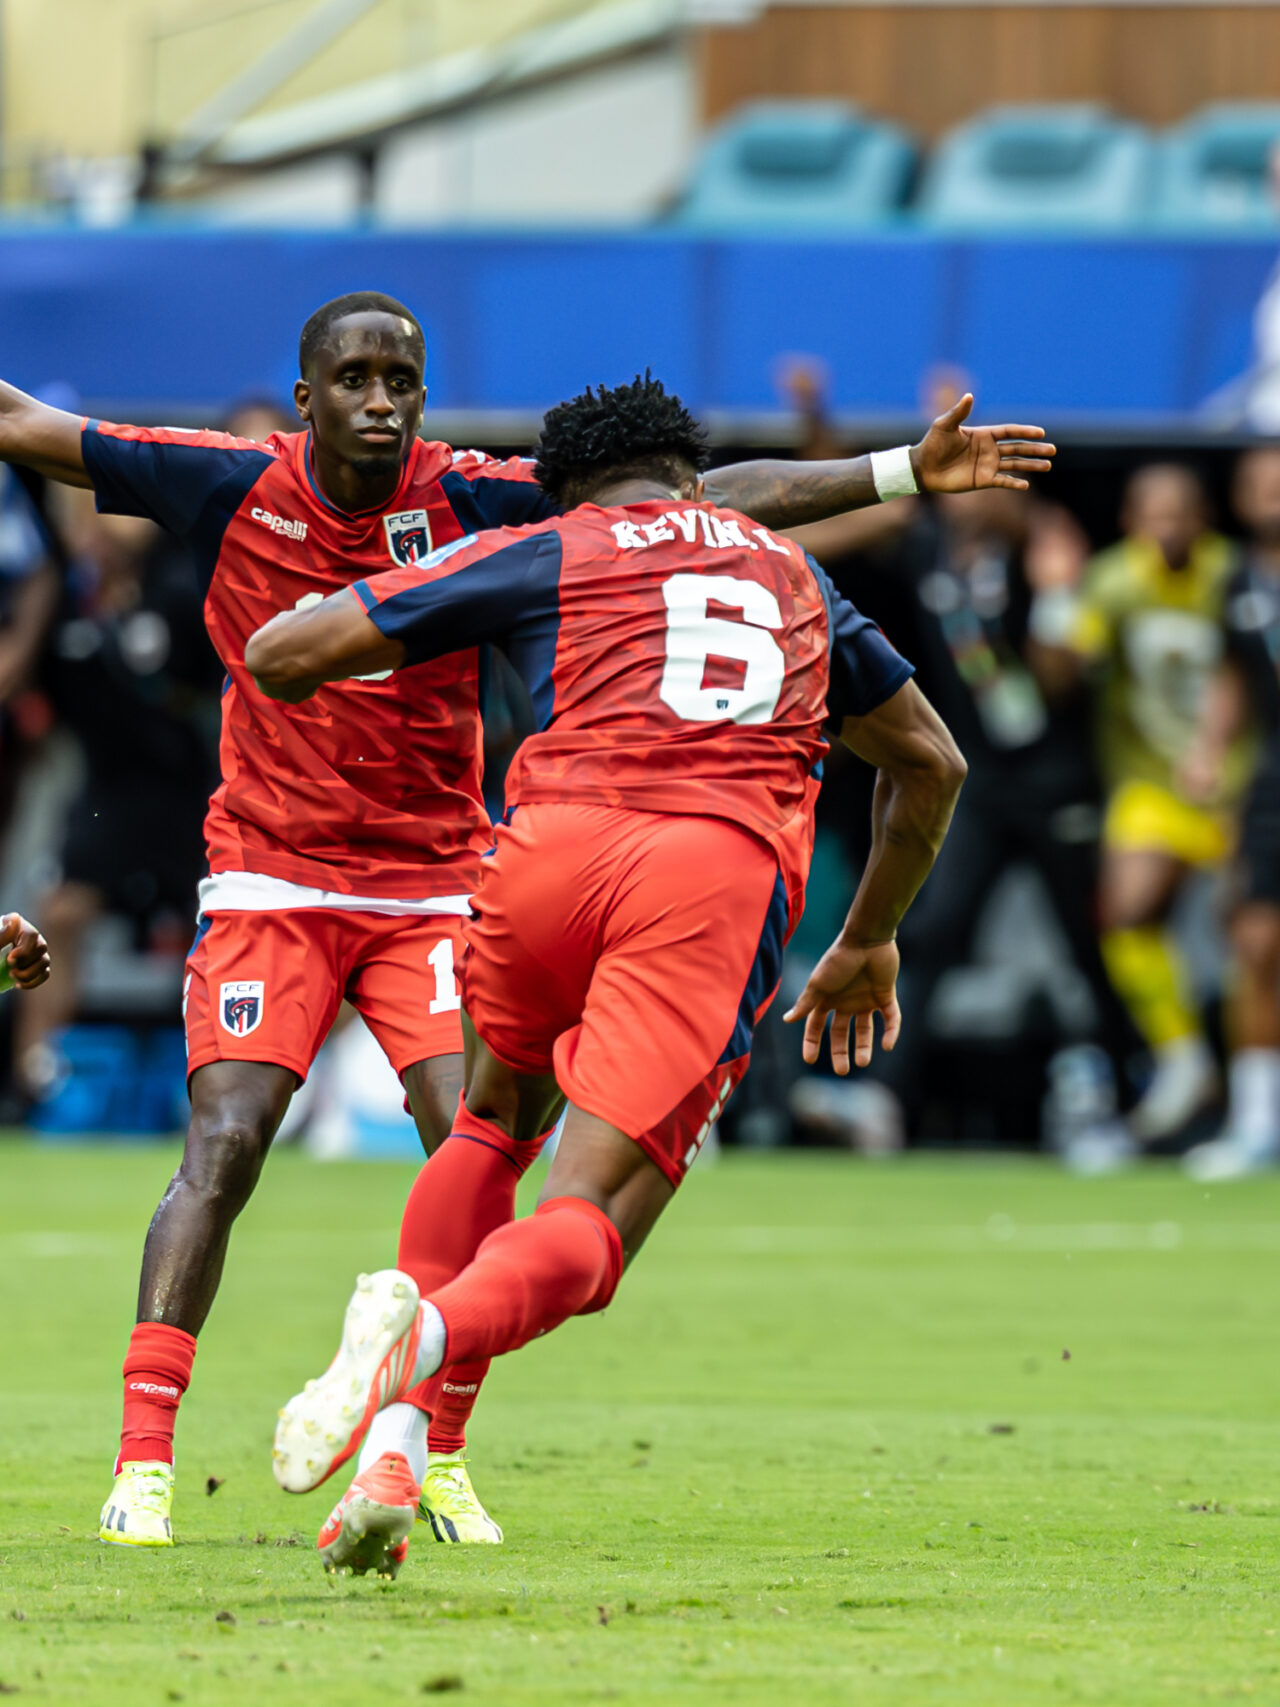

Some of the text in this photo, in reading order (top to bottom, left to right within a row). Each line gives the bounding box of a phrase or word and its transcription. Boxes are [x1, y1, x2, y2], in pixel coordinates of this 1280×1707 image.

[251, 507, 308, 538] capelli
[387, 512, 424, 528] FCF
[659, 573, 786, 725] 6
[427, 938, 470, 1015] 1
[224, 984, 260, 993] FCF
[130, 1382, 179, 1399] capelli
[442, 1382, 478, 1395] pelli
